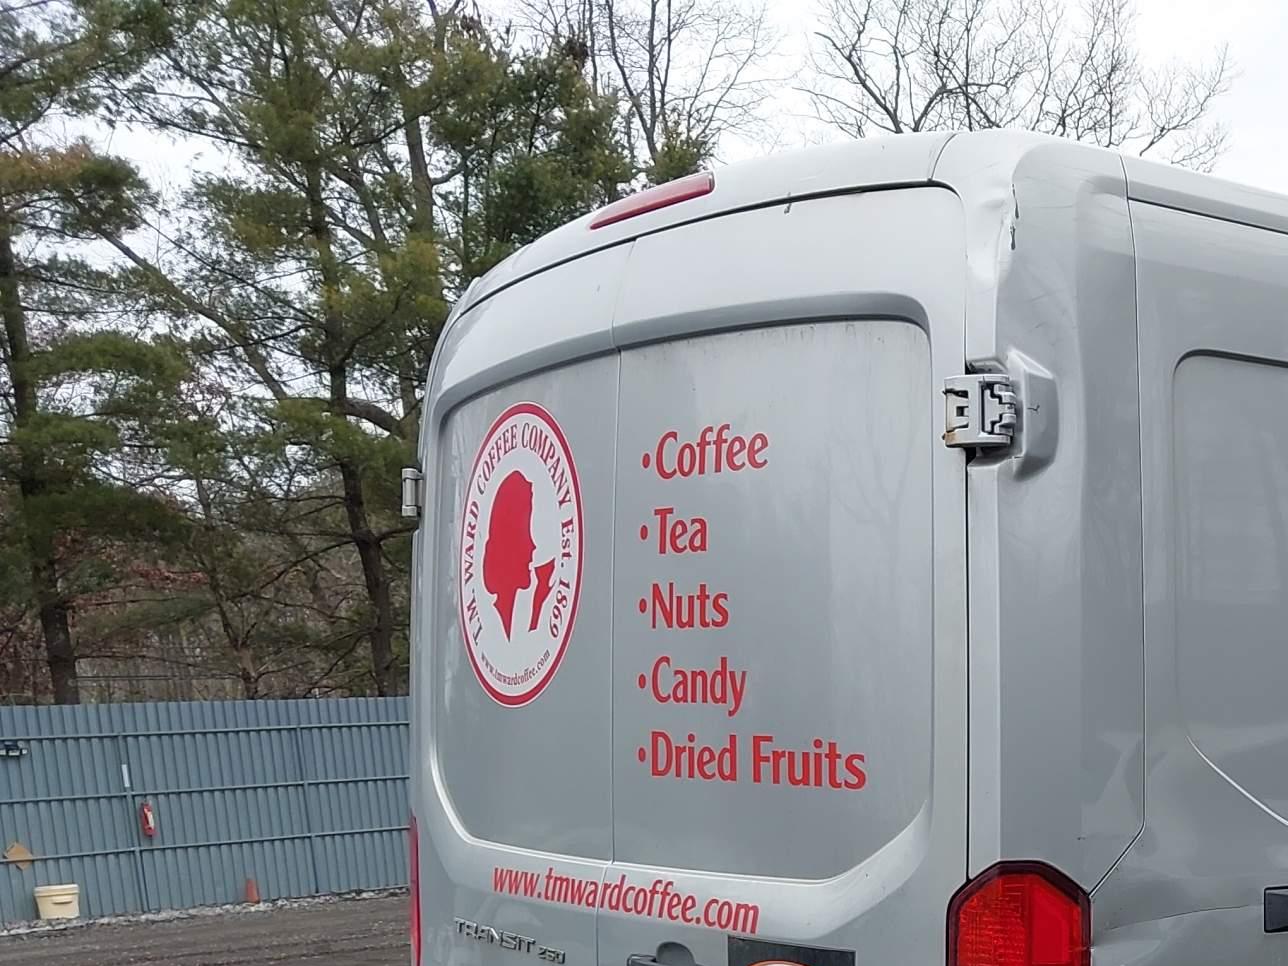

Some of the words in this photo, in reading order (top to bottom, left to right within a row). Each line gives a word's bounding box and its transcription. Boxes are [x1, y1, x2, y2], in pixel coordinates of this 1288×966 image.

[477, 424, 518, 495] COFFEE
[521, 422, 572, 510] COMPANY
[655, 424, 769, 480] Coffee
[464, 500, 480, 585] WARD
[561, 517, 575, 568] Est.
[654, 507, 708, 555] Tea
[549, 577, 571, 639] 1869
[651, 582, 730, 630] Nuts
[652, 656, 748, 717] Candy
[651, 731, 738, 783] Dried
[752, 735, 867, 791] Fruits
[492, 865, 760, 935] www.tmwardcoffee.com
[455, 917, 537, 954] TRANSIT
